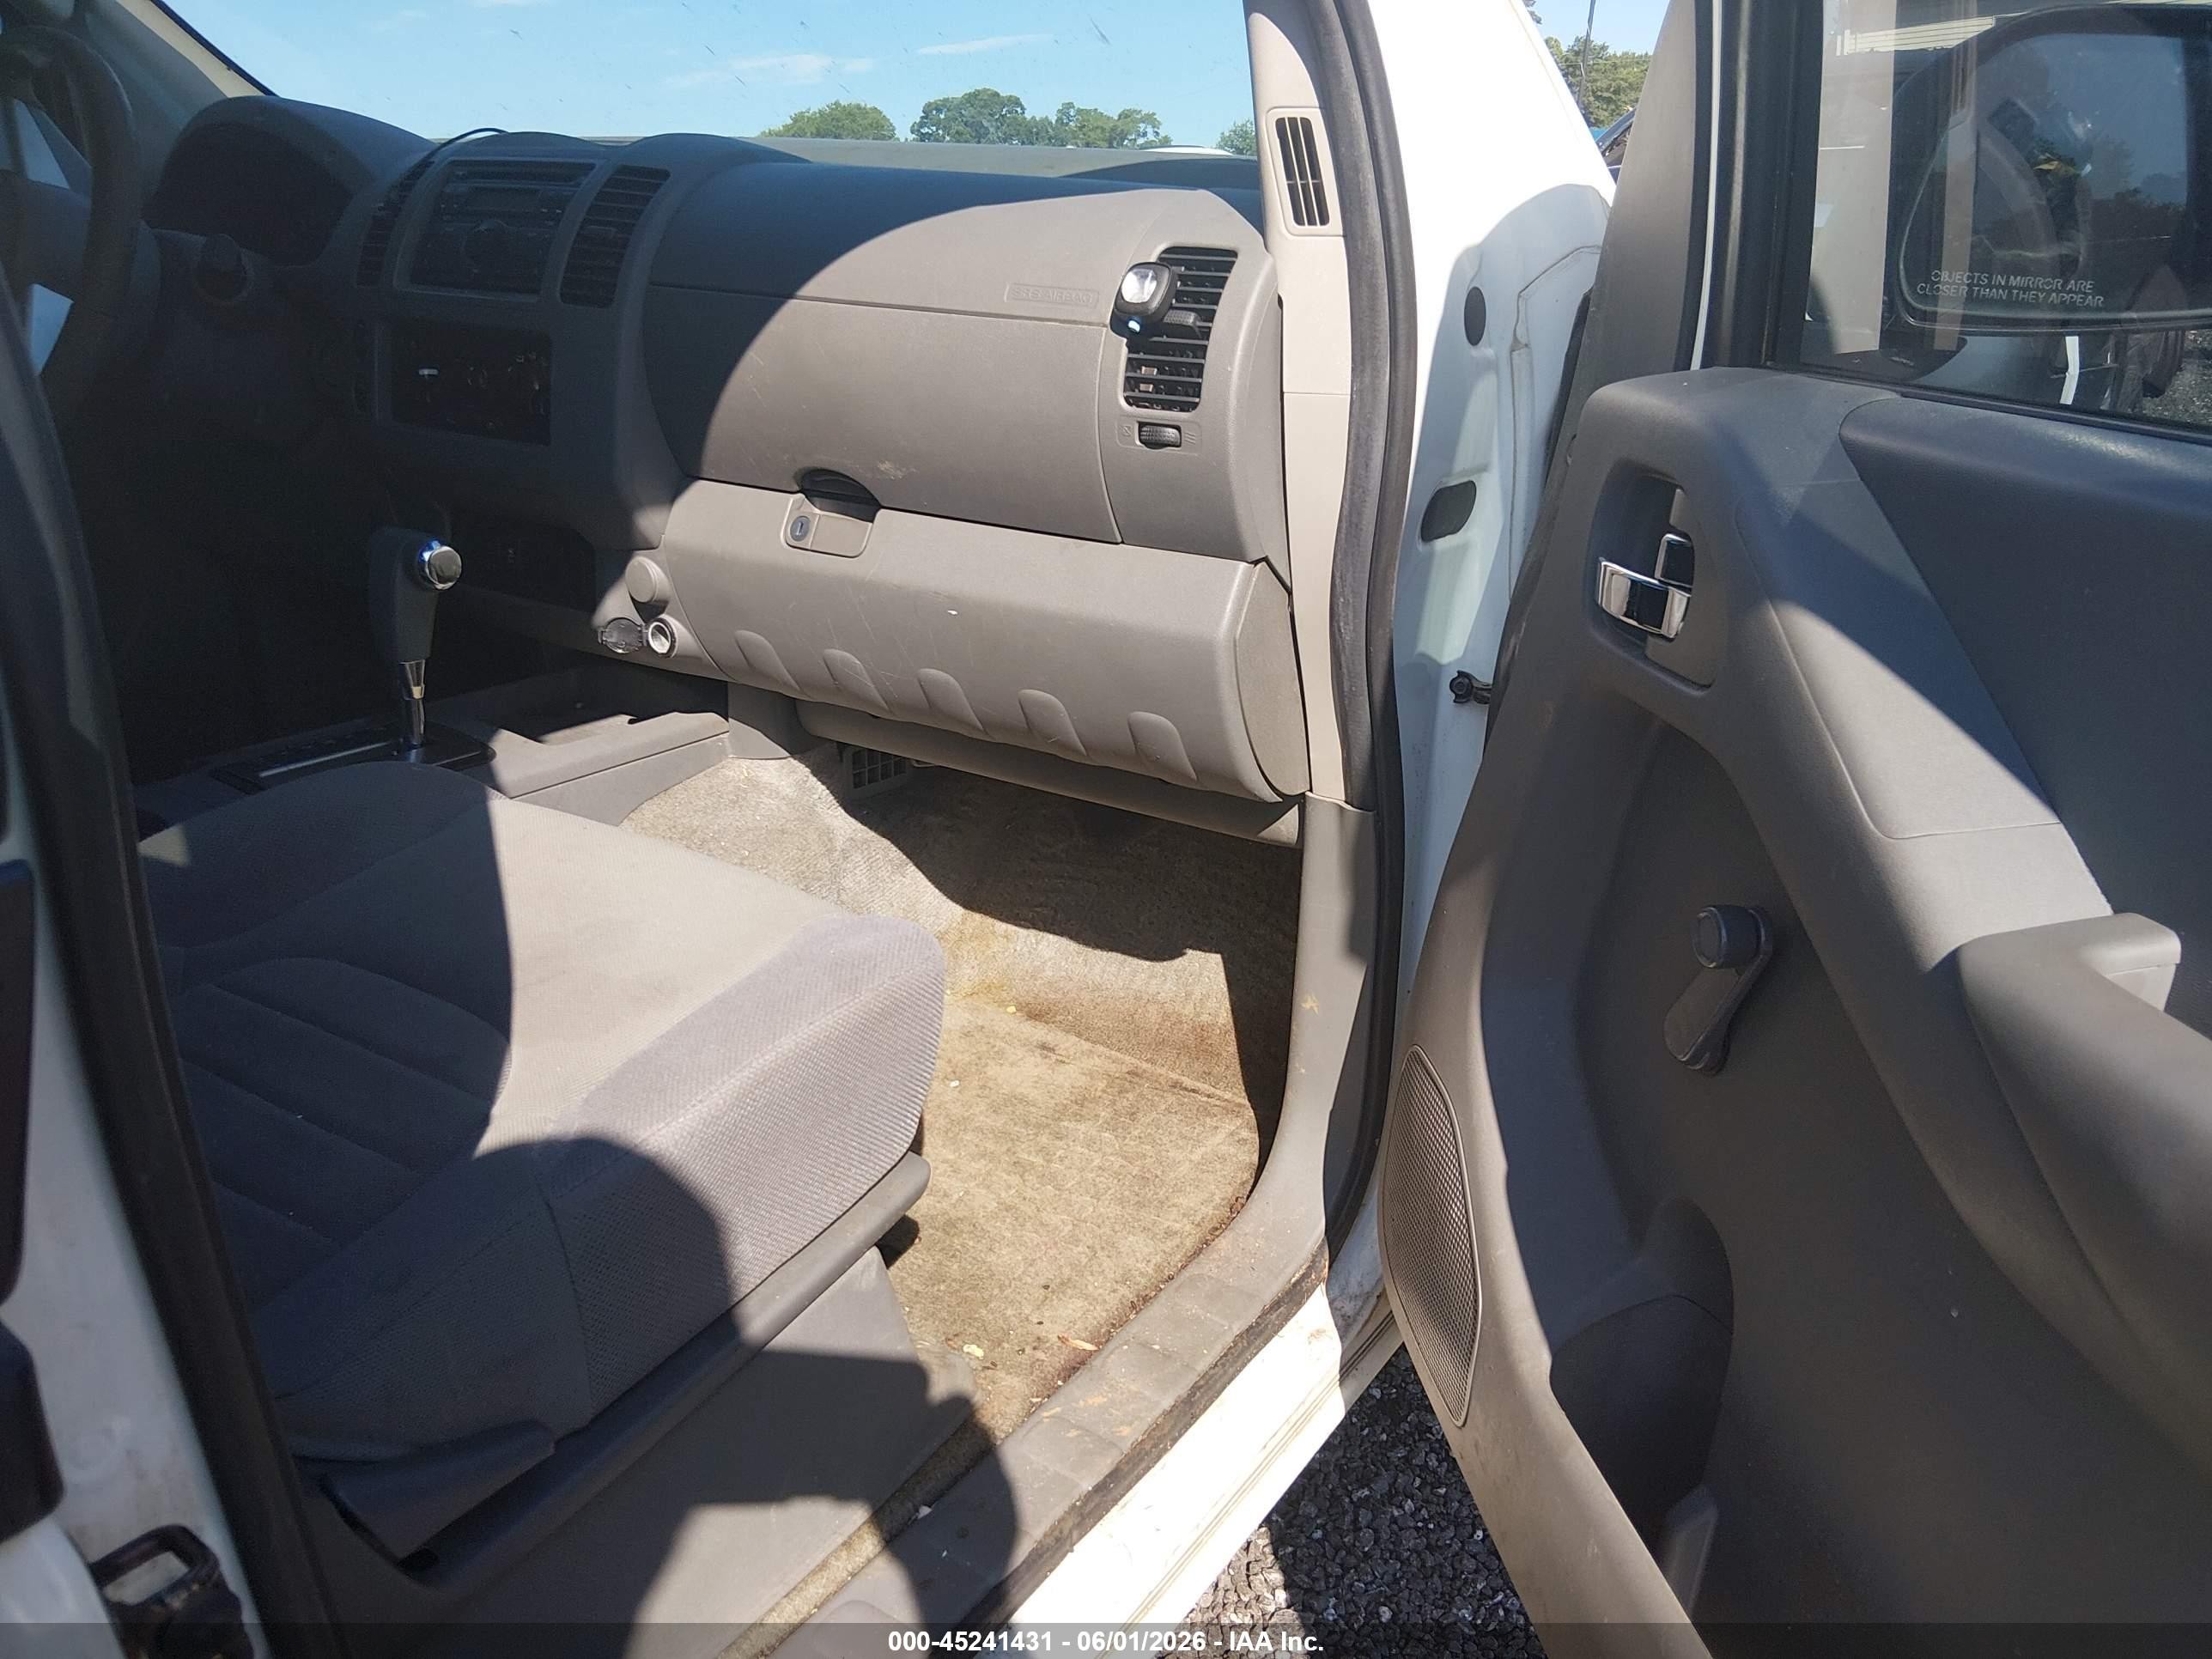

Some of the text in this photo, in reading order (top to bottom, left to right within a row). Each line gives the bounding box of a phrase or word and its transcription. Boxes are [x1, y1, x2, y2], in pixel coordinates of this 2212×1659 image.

[1931, 270, 2094, 293] OBJECTS IN MIRROR ARE
[1917, 283, 2104, 307] CLOSER THAN THEY APPEAR
